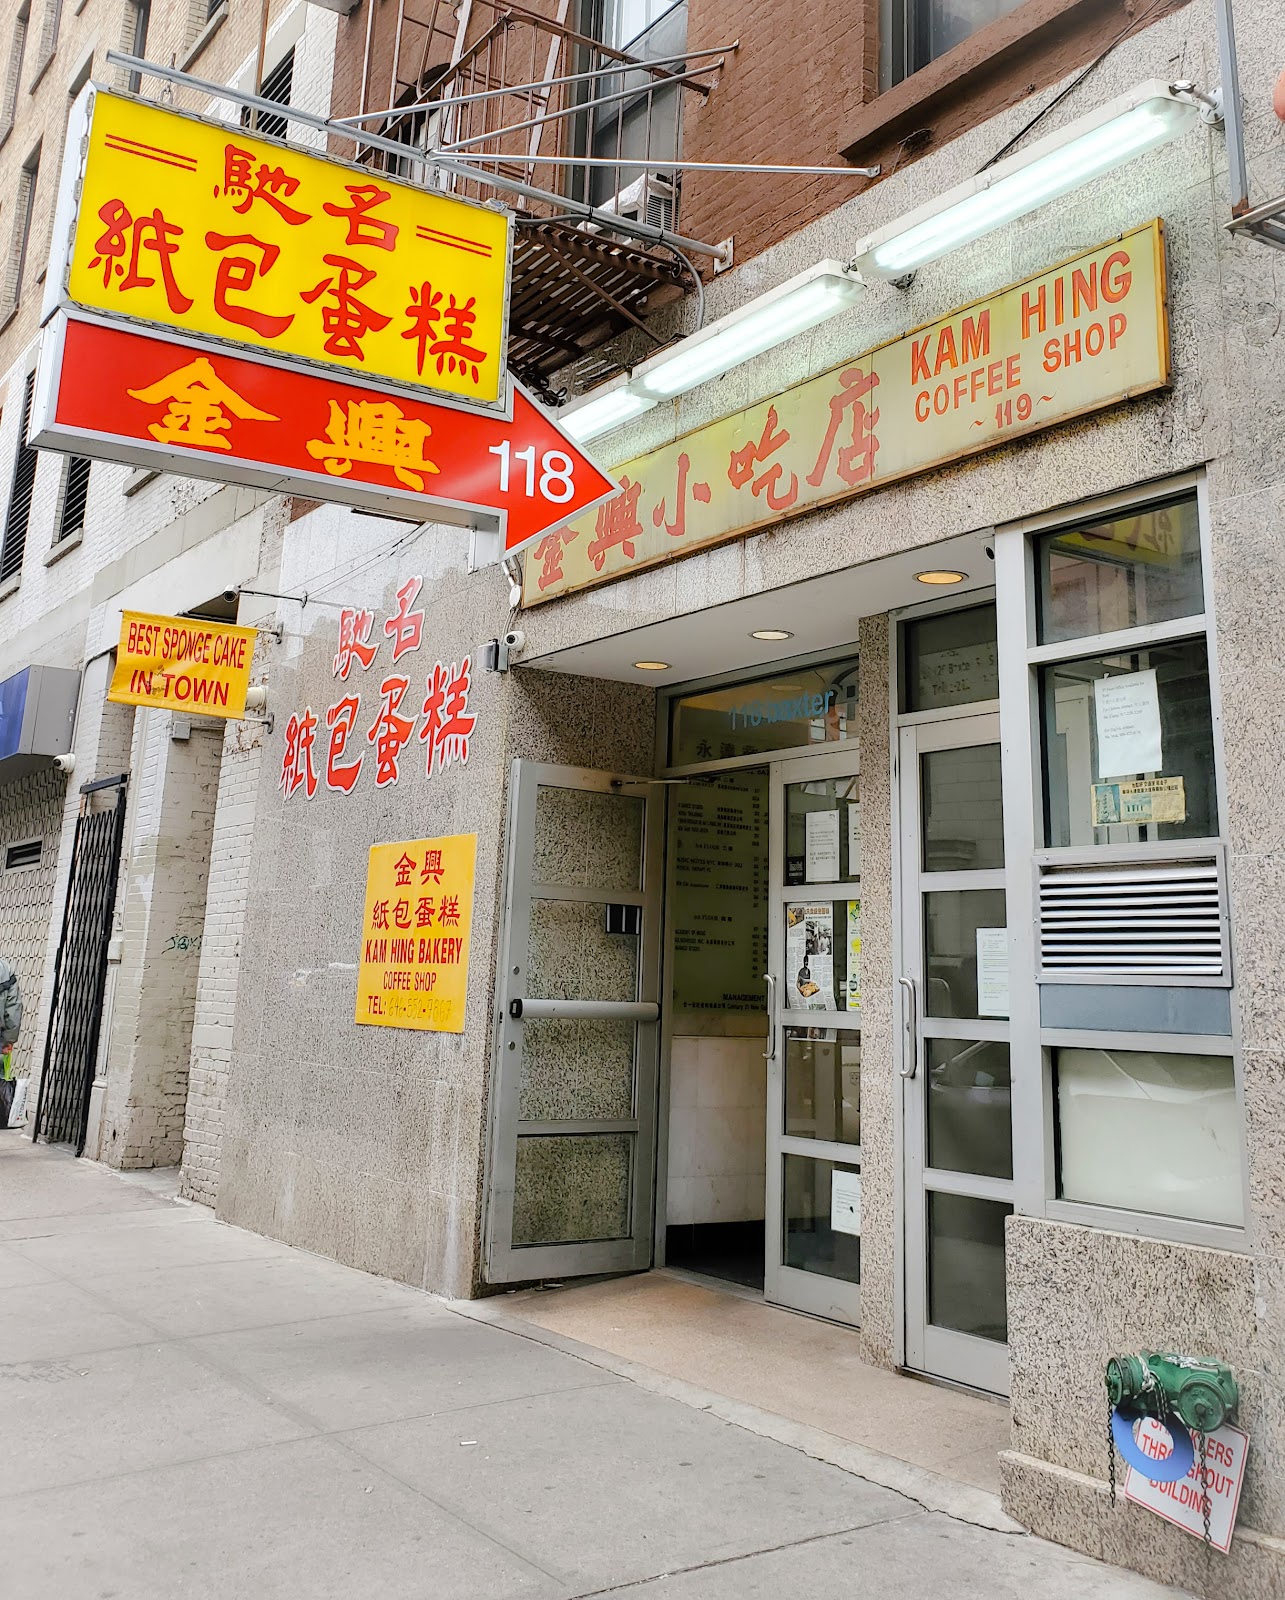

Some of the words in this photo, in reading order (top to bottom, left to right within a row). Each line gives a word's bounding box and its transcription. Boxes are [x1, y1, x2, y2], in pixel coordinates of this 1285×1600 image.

[213, 143, 400, 252] 馳名
[87, 199, 488, 385] 紙包蛋糕
[911, 309, 991, 386] KAM
[1021, 250, 1133, 341] HING
[914, 352, 1021, 423] COFFEE
[1042, 312, 1128, 373] SHOP
[126, 356, 441, 492] 金興
[488, 439, 576, 505] 118
[127, 622, 161, 657] BEST
[161, 627, 213, 664] SPONGE
[213, 634, 248, 670] CAKE
[333, 574, 425, 681] 馳名
[129, 669, 154, 696] IN
[161, 672, 230, 707] TOWN
[278, 655, 478, 800] 紙包蛋糕
[393, 849, 446, 887] 金興
[371, 893, 461, 931] 紙包蛋糕
[364, 938, 387, 963] KAM
[390, 938, 415, 964] HING
[418, 937, 463, 964] BAKERY
[383, 971, 411, 991] COFFEE
[414, 971, 437, 992] SHOP
[368, 995, 387, 1016] TEL:
